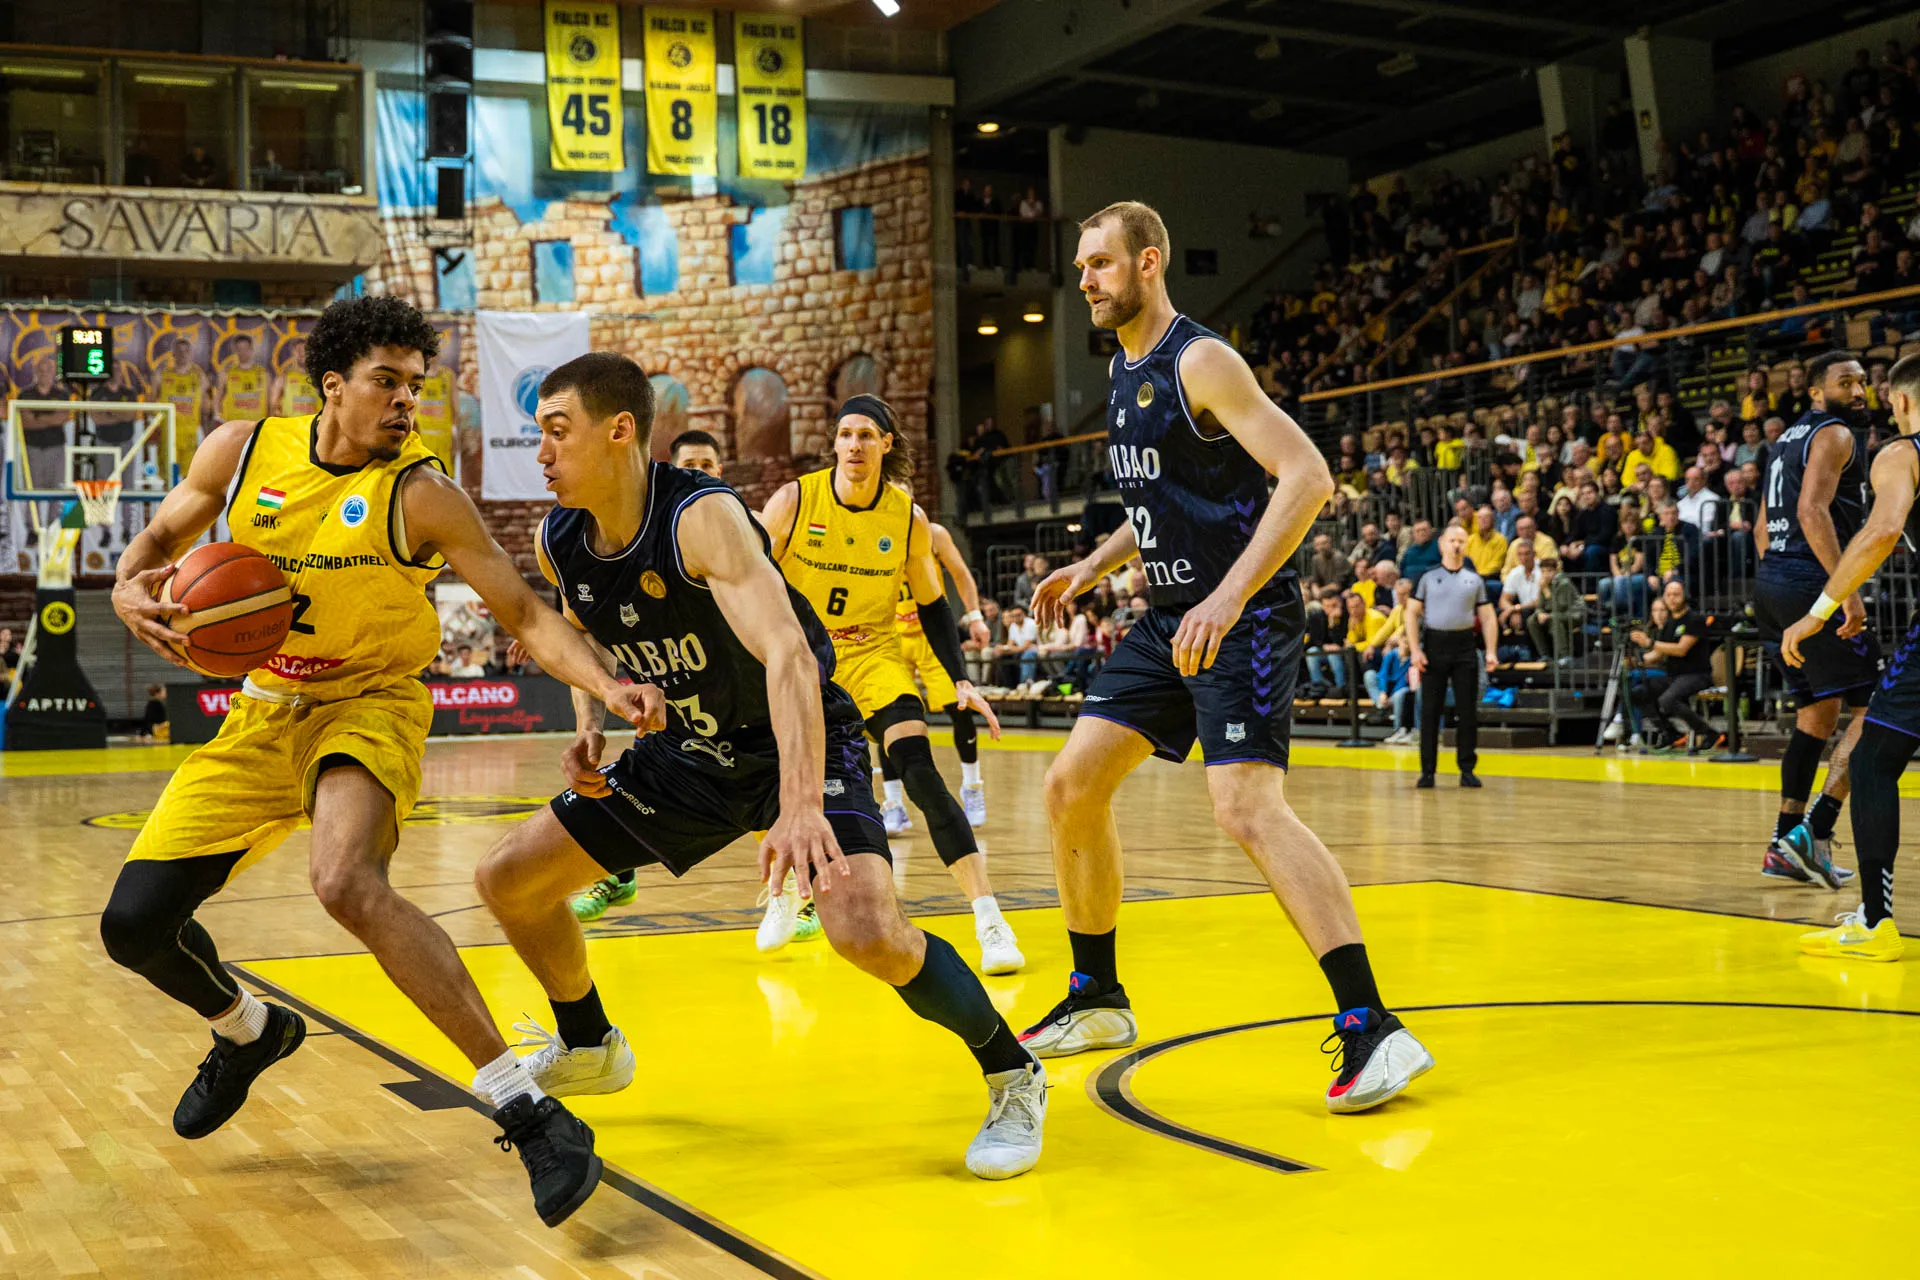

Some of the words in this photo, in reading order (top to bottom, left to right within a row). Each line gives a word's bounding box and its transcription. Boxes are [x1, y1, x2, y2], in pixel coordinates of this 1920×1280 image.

[562, 94, 611, 137] 45
[671, 100, 693, 141] 8
[753, 103, 792, 146] 18
[61, 199, 331, 257] SAVARIA
[88, 348, 105, 377] 5
[1109, 444, 1161, 480] ILBAO
[1146, 557, 1196, 586] rne
[826, 587, 849, 617] 6
[234, 619, 285, 643] molten
[611, 632, 708, 678] ILBAO
[27, 698, 88, 712] APTIV
